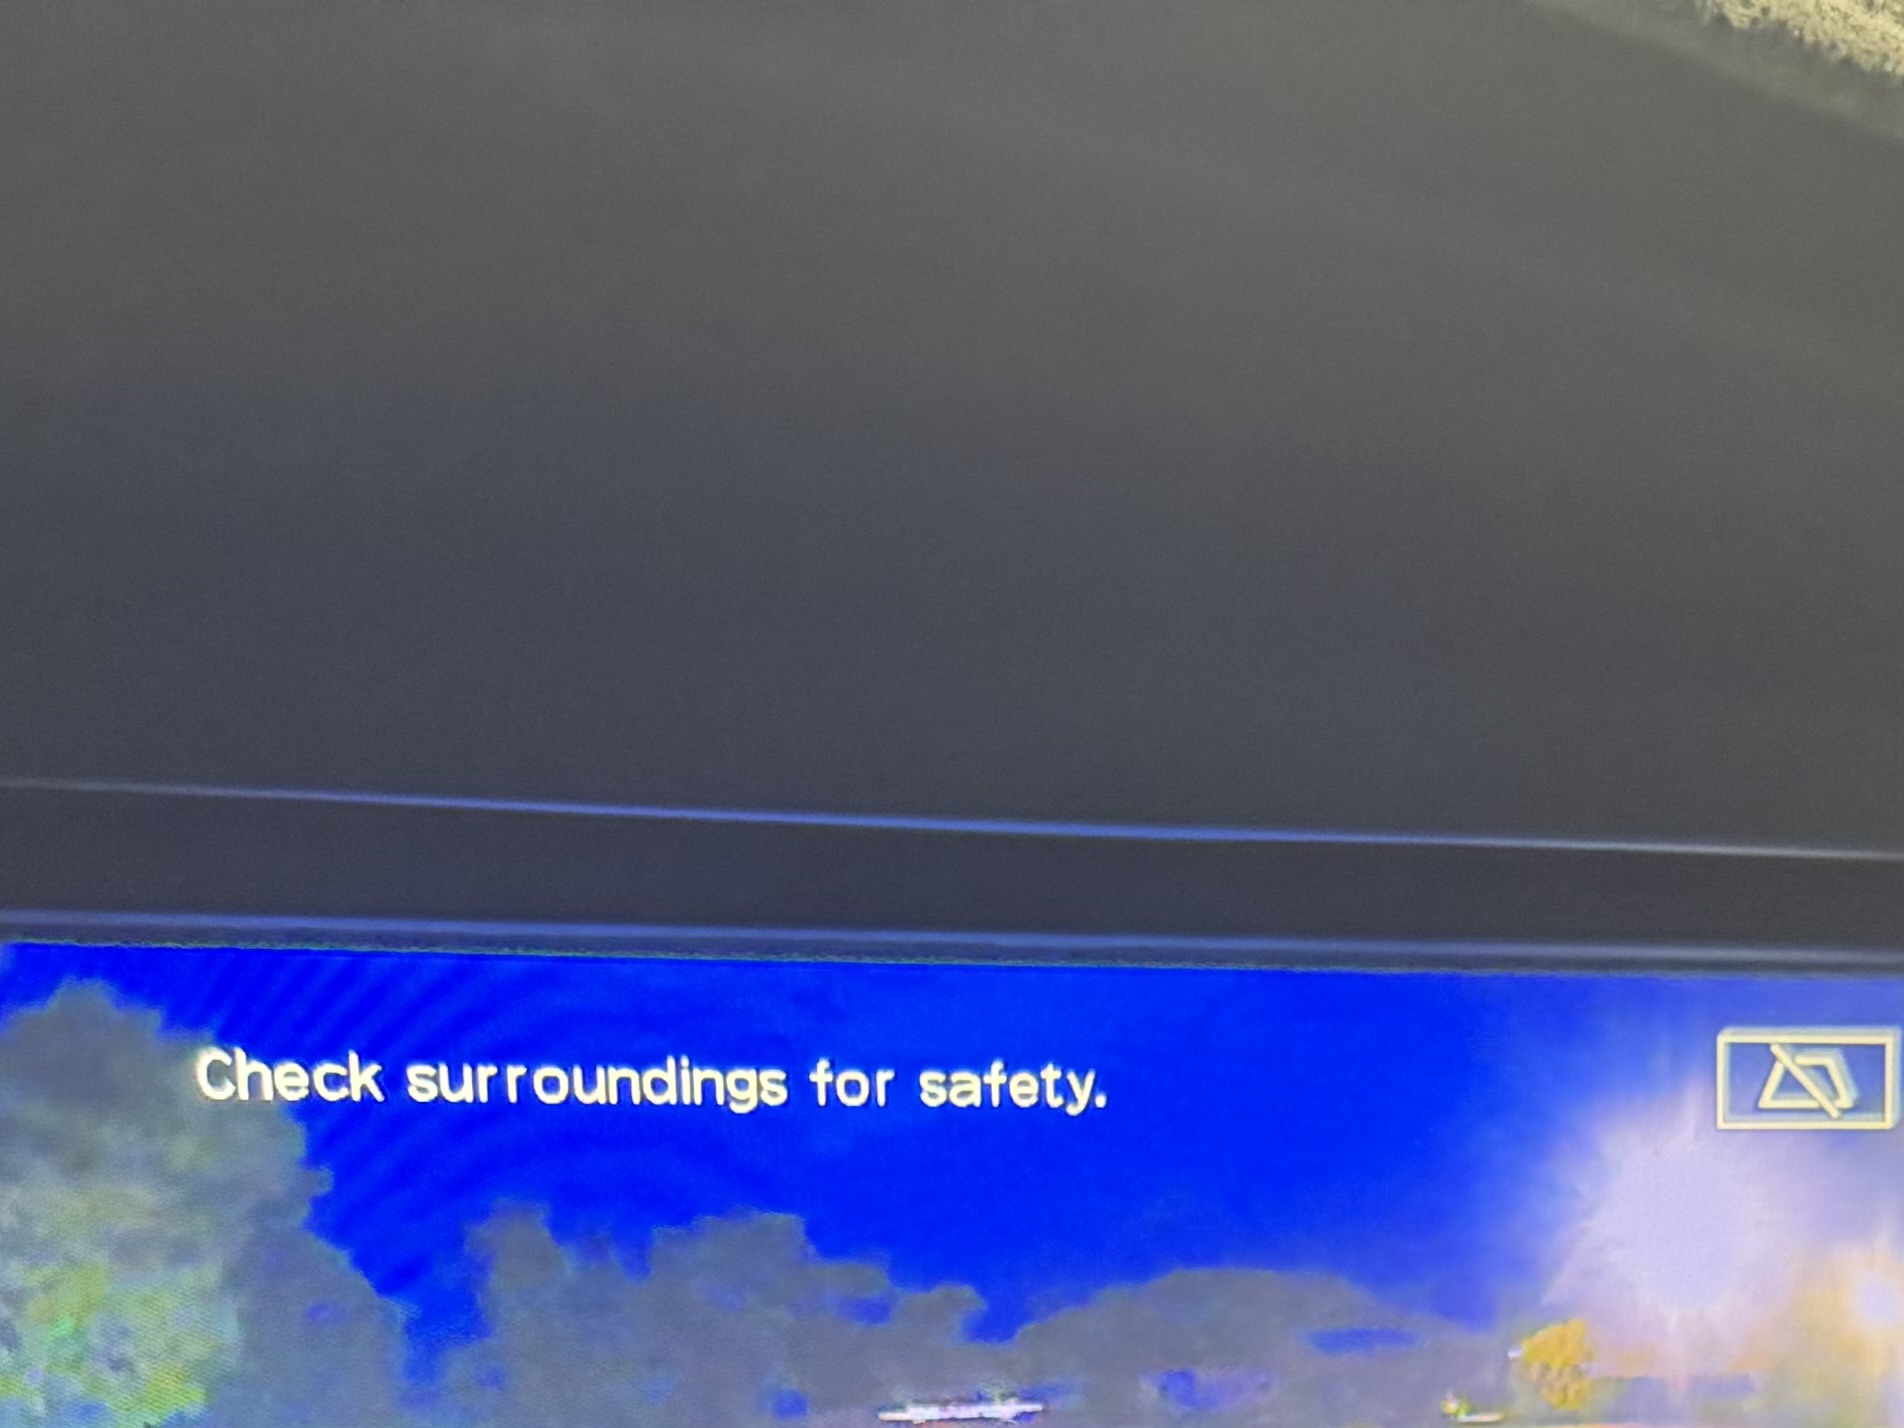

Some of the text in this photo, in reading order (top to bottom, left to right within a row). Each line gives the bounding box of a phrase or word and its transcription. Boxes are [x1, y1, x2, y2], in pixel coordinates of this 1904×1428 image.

[194, 1045, 1108, 1116] Check surroundings for safety.
